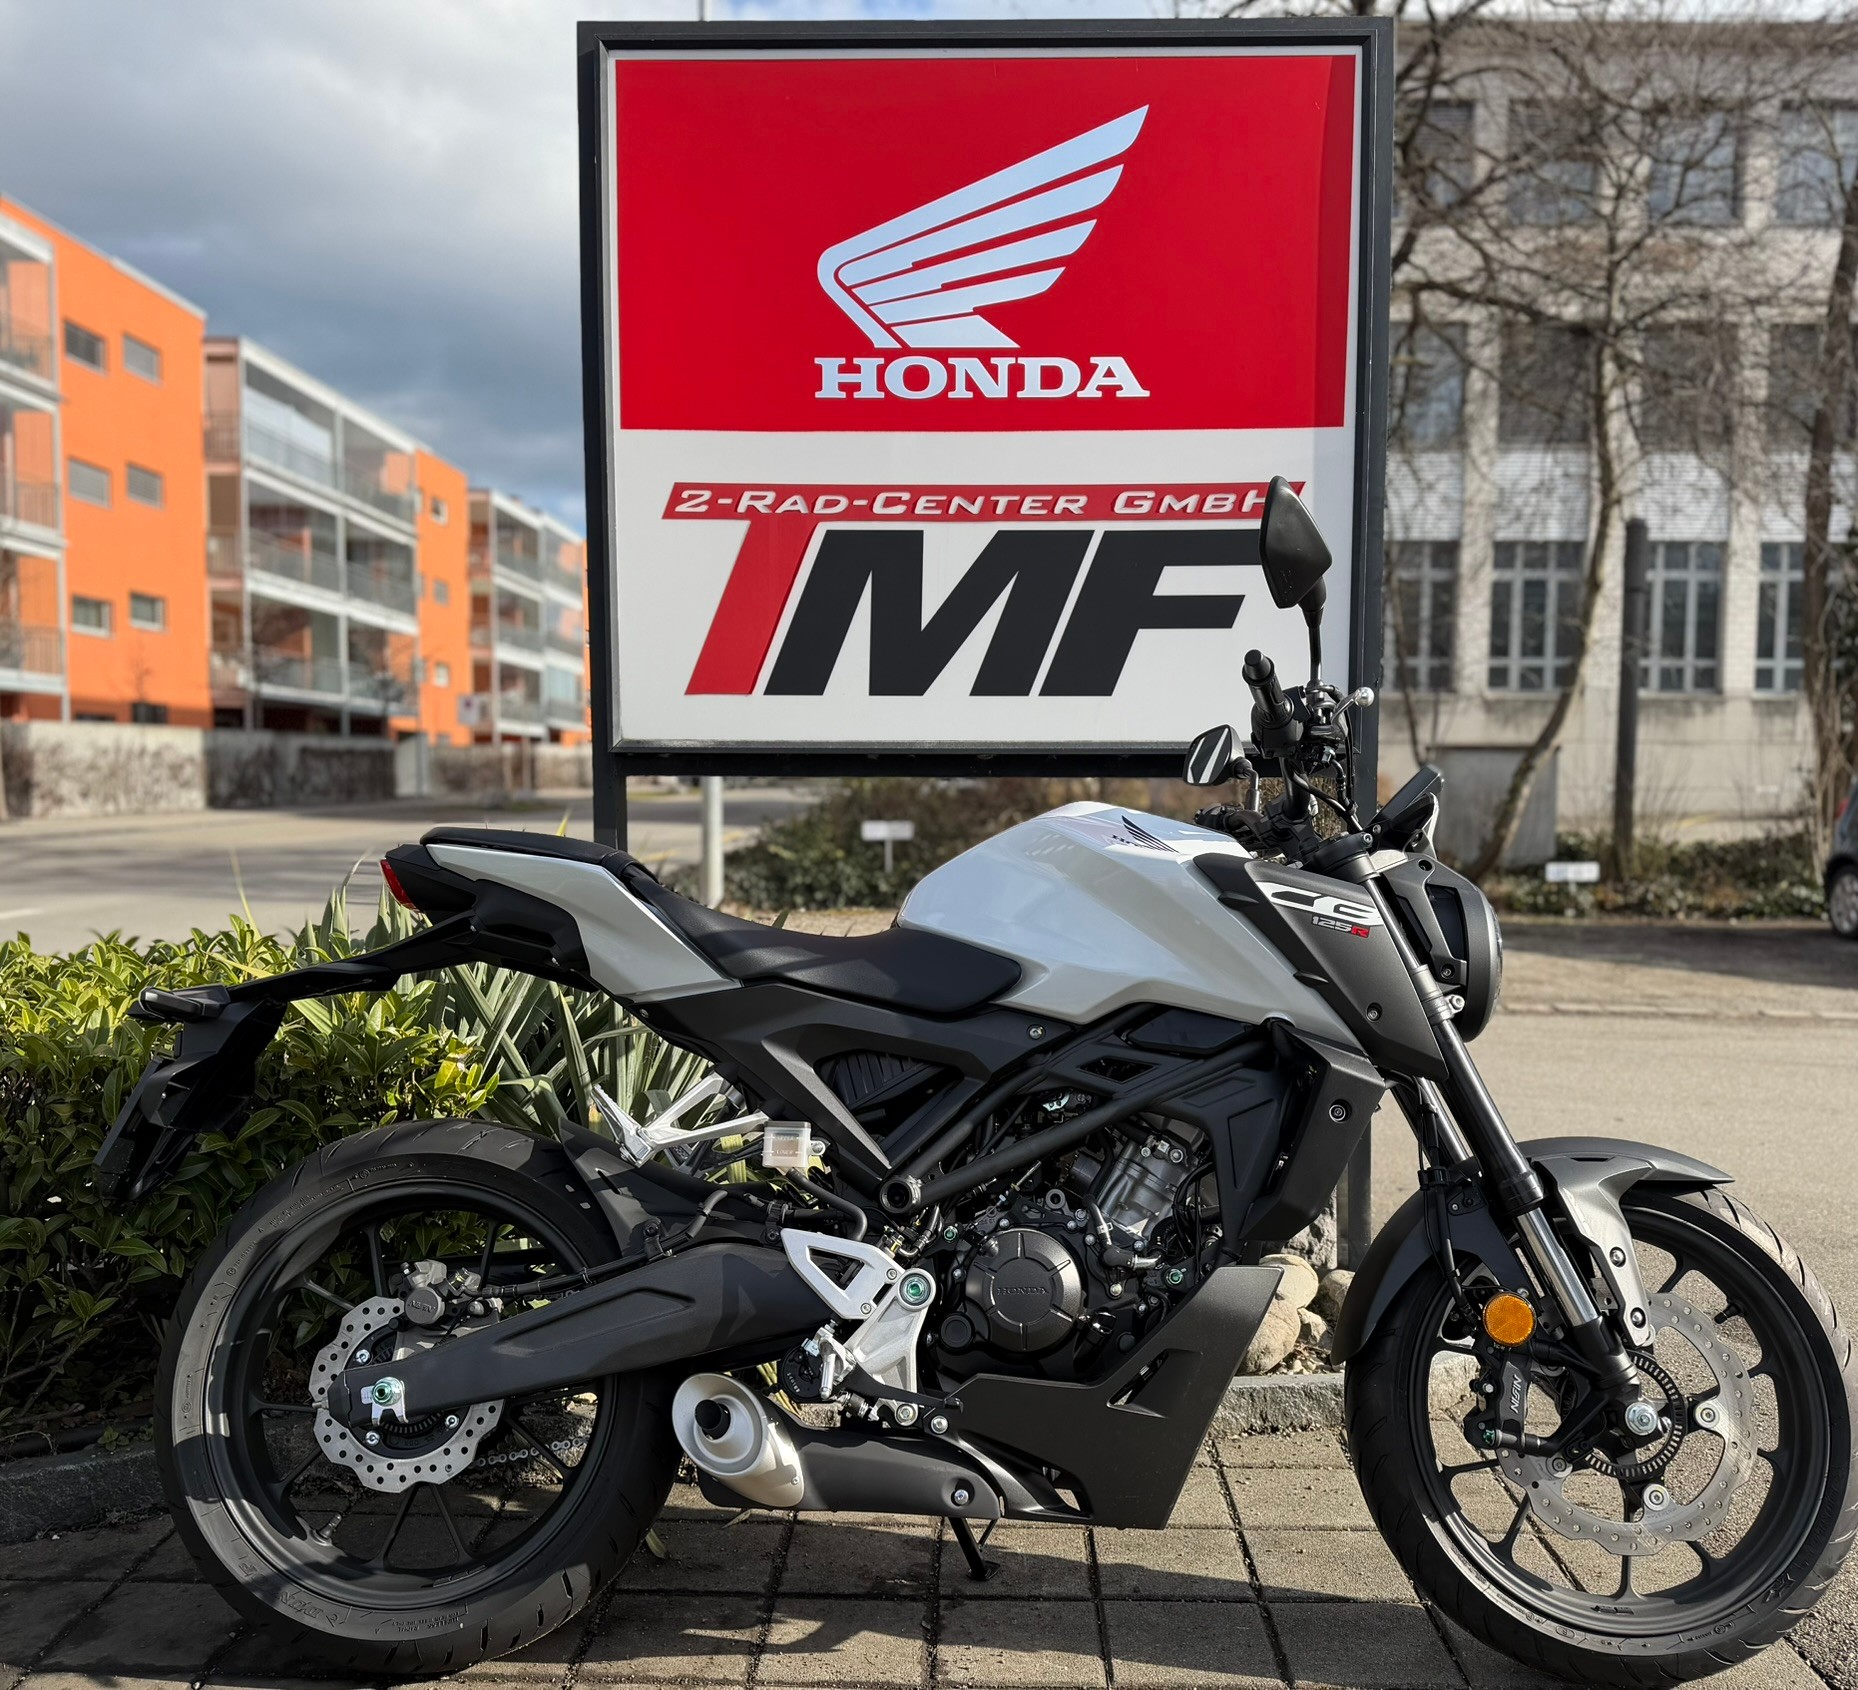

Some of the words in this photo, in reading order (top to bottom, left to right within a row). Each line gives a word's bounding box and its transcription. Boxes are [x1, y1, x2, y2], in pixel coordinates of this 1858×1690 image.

[814, 355, 1151, 399] HONDA
[663, 482, 1262, 696] TMF
[1311, 915, 1371, 939] 125R
[996, 1286, 1049, 1297] HONDA
